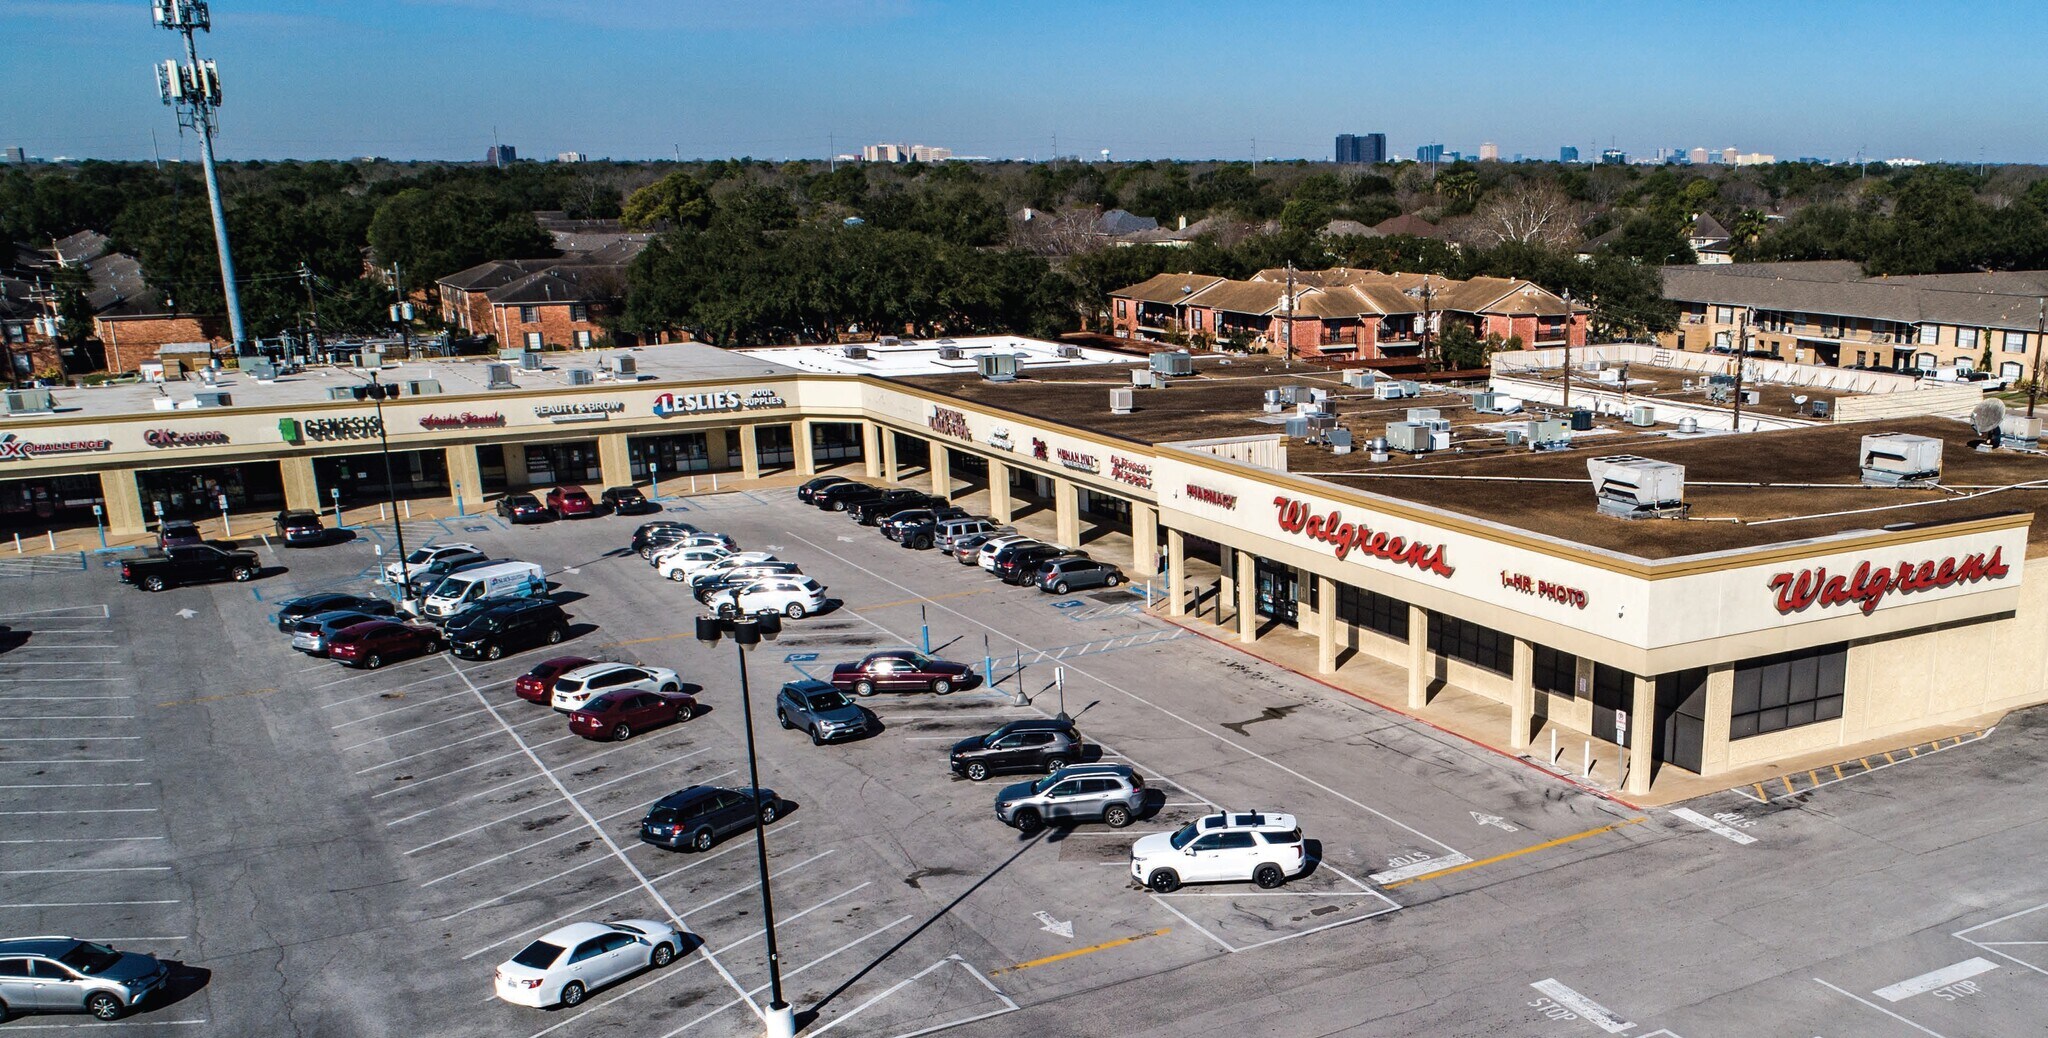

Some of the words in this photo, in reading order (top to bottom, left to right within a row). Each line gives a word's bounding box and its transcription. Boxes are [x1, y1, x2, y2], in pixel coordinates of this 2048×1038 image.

[661, 390, 739, 413] LESLIE'S
[743, 397, 782, 406] SUPPLIES
[751, 389, 774, 397] POOL
[533, 404, 577, 415] BEAUTY
[588, 400, 620, 411] BROW
[305, 416, 379, 437] GENESIS
[23, 440, 105, 453] CHALLENGE
[1186, 484, 1235, 510] PHARMACY
[1273, 496, 1456, 578] Walgreens
[1767, 545, 2011, 614] Walgreens
[1538, 579, 1588, 610] PHOTO
[1388, 851, 1431, 868] STOP
[1932, 980, 1981, 1001] STOP
[1527, 997, 1578, 1020] STOP
